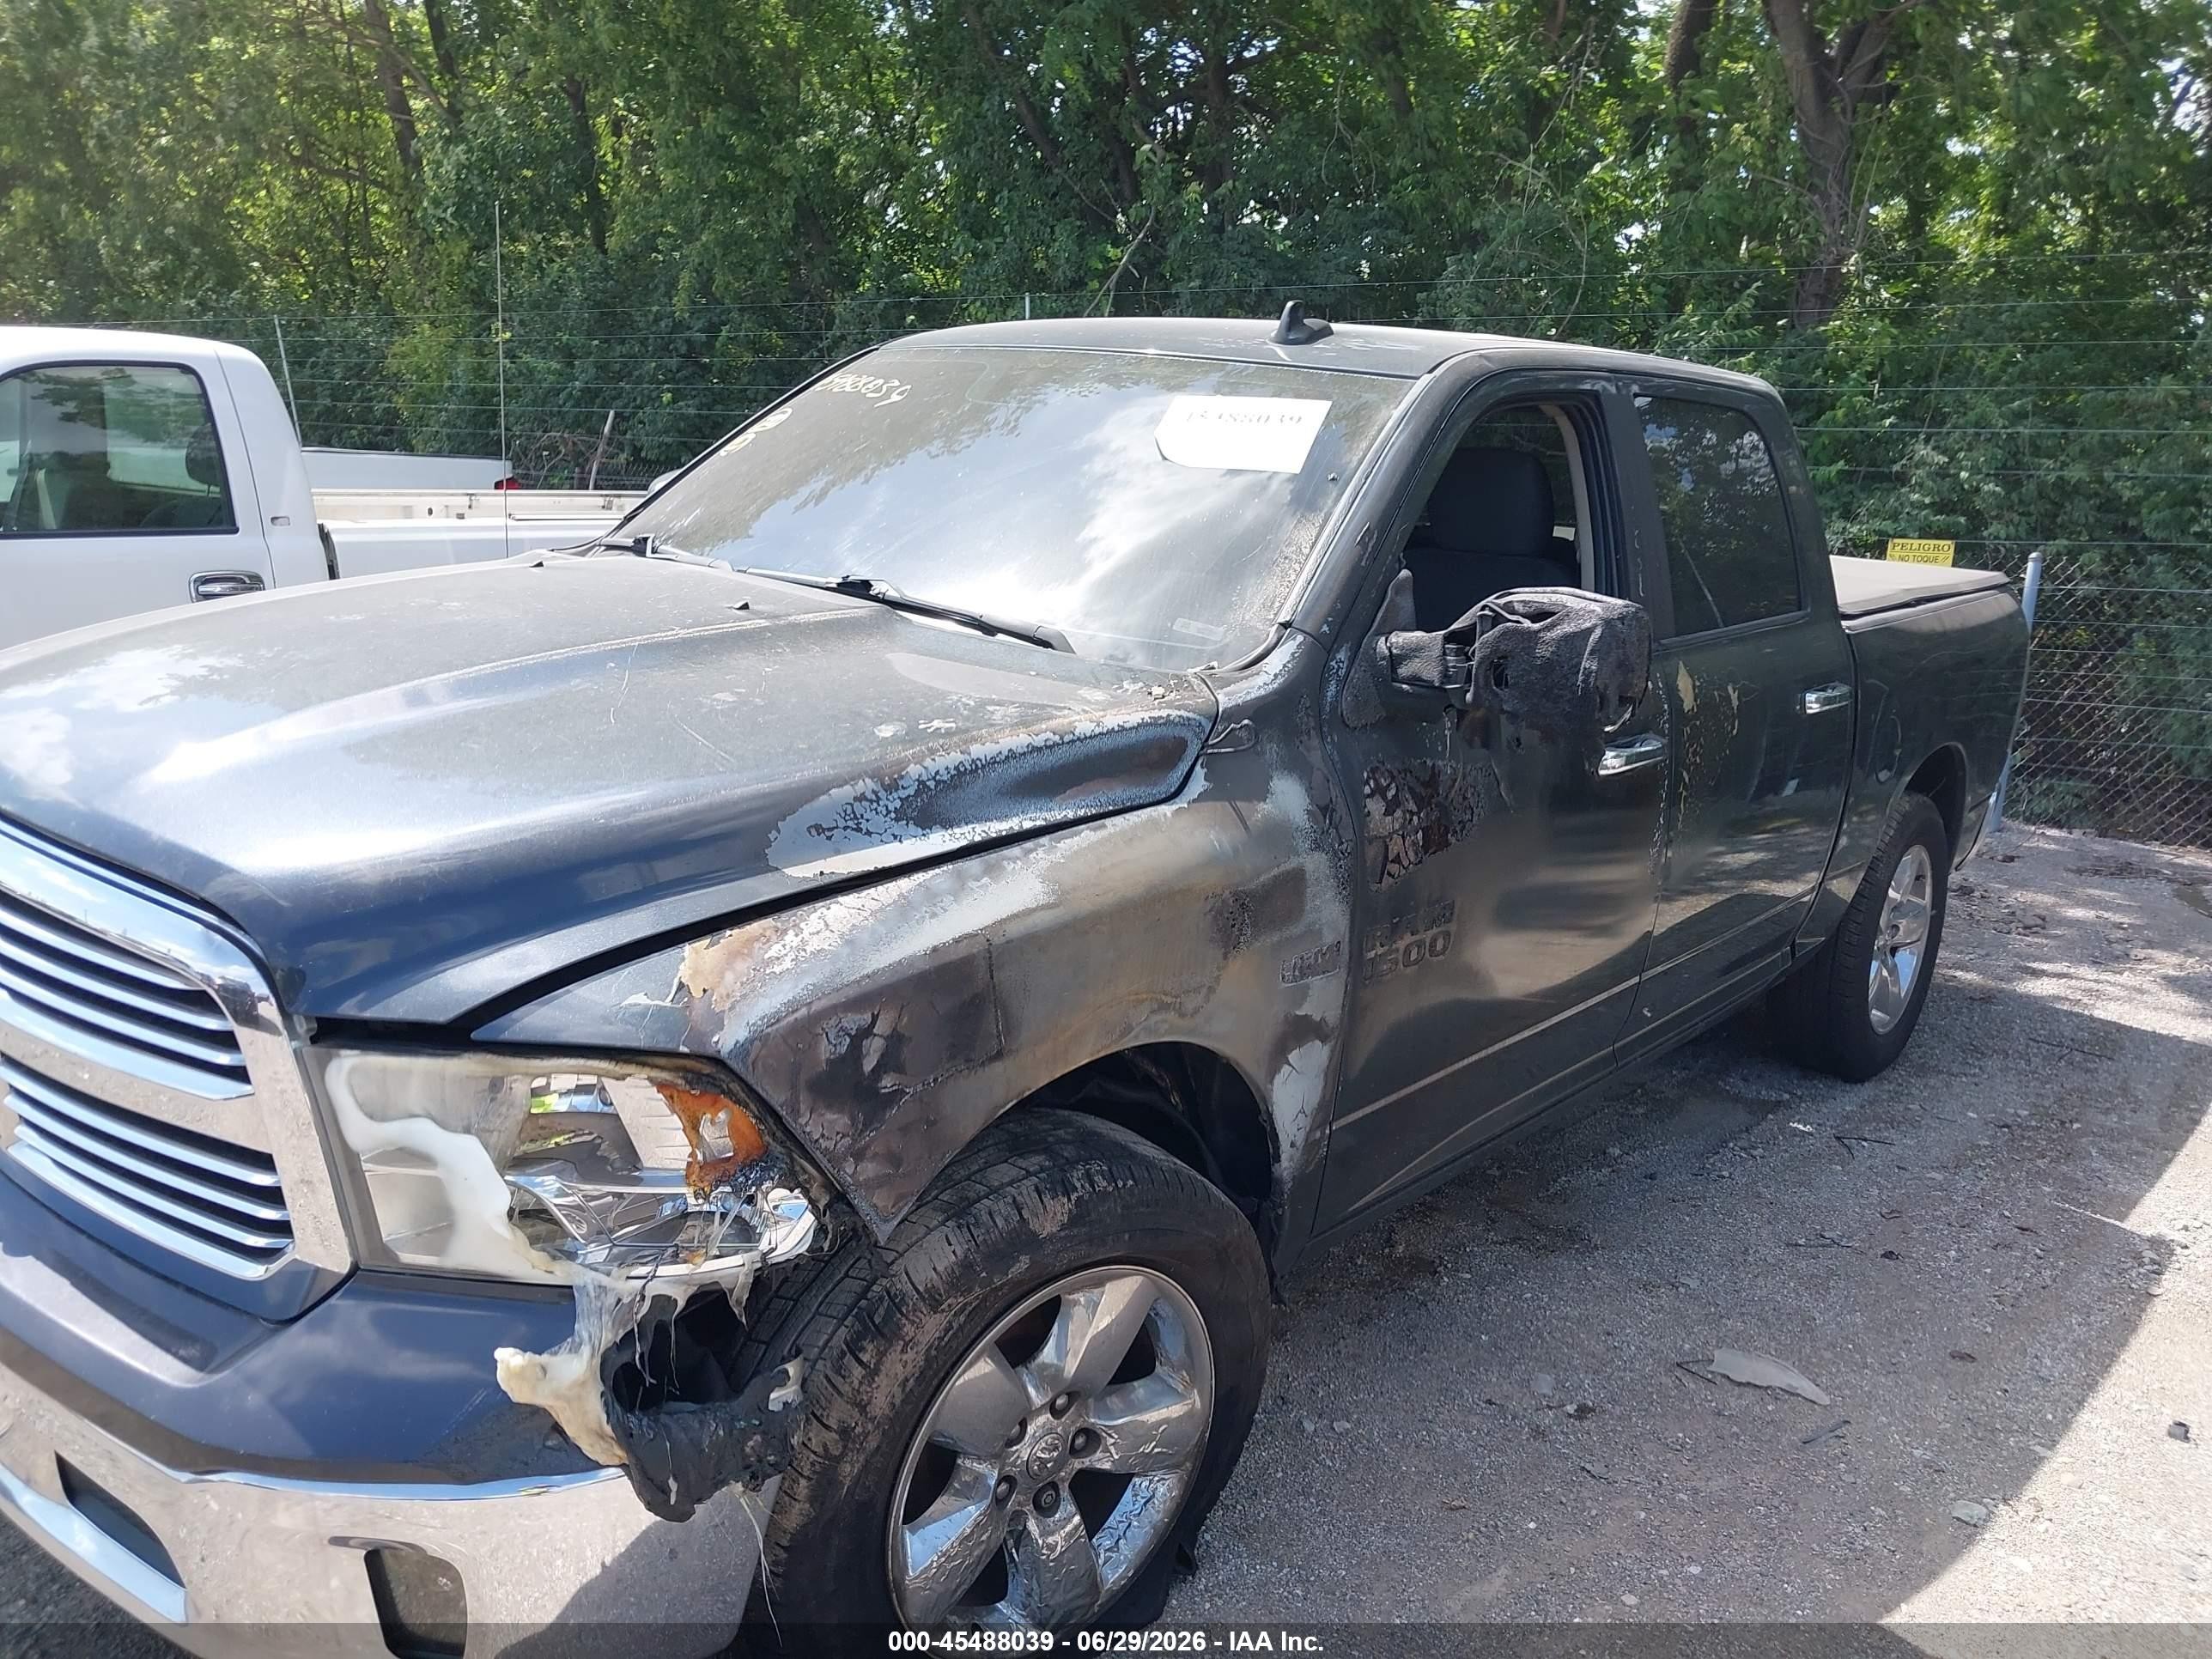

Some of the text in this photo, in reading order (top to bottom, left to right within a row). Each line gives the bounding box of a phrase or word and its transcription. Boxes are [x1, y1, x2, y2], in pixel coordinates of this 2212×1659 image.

[1892, 542, 1951, 553] PELIGRO
[1898, 554, 1940, 564] NO TOQUE
